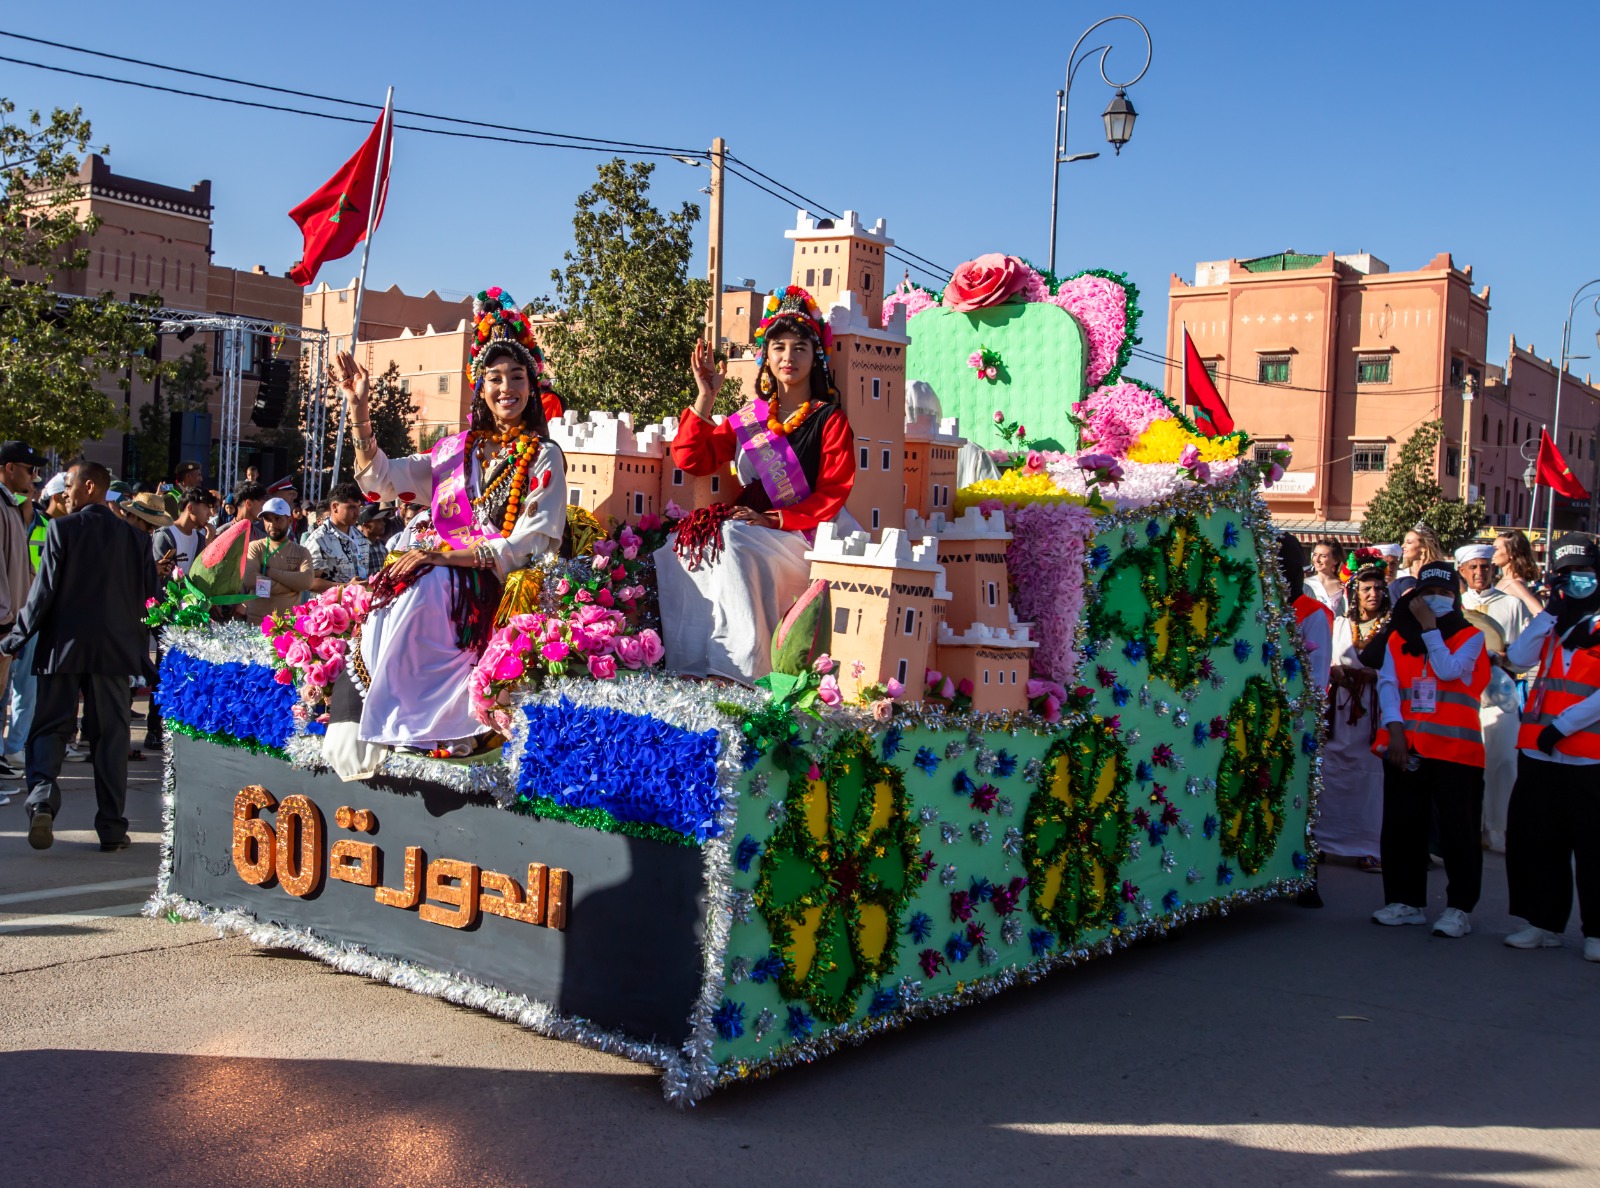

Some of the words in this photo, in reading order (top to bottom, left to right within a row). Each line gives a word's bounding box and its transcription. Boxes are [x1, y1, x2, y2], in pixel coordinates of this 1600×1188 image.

[1421, 568, 1451, 581] SECURITE
[1555, 544, 1586, 560] SECURITE
[232, 784, 323, 897] 60
[330, 806, 568, 929] الدورة
